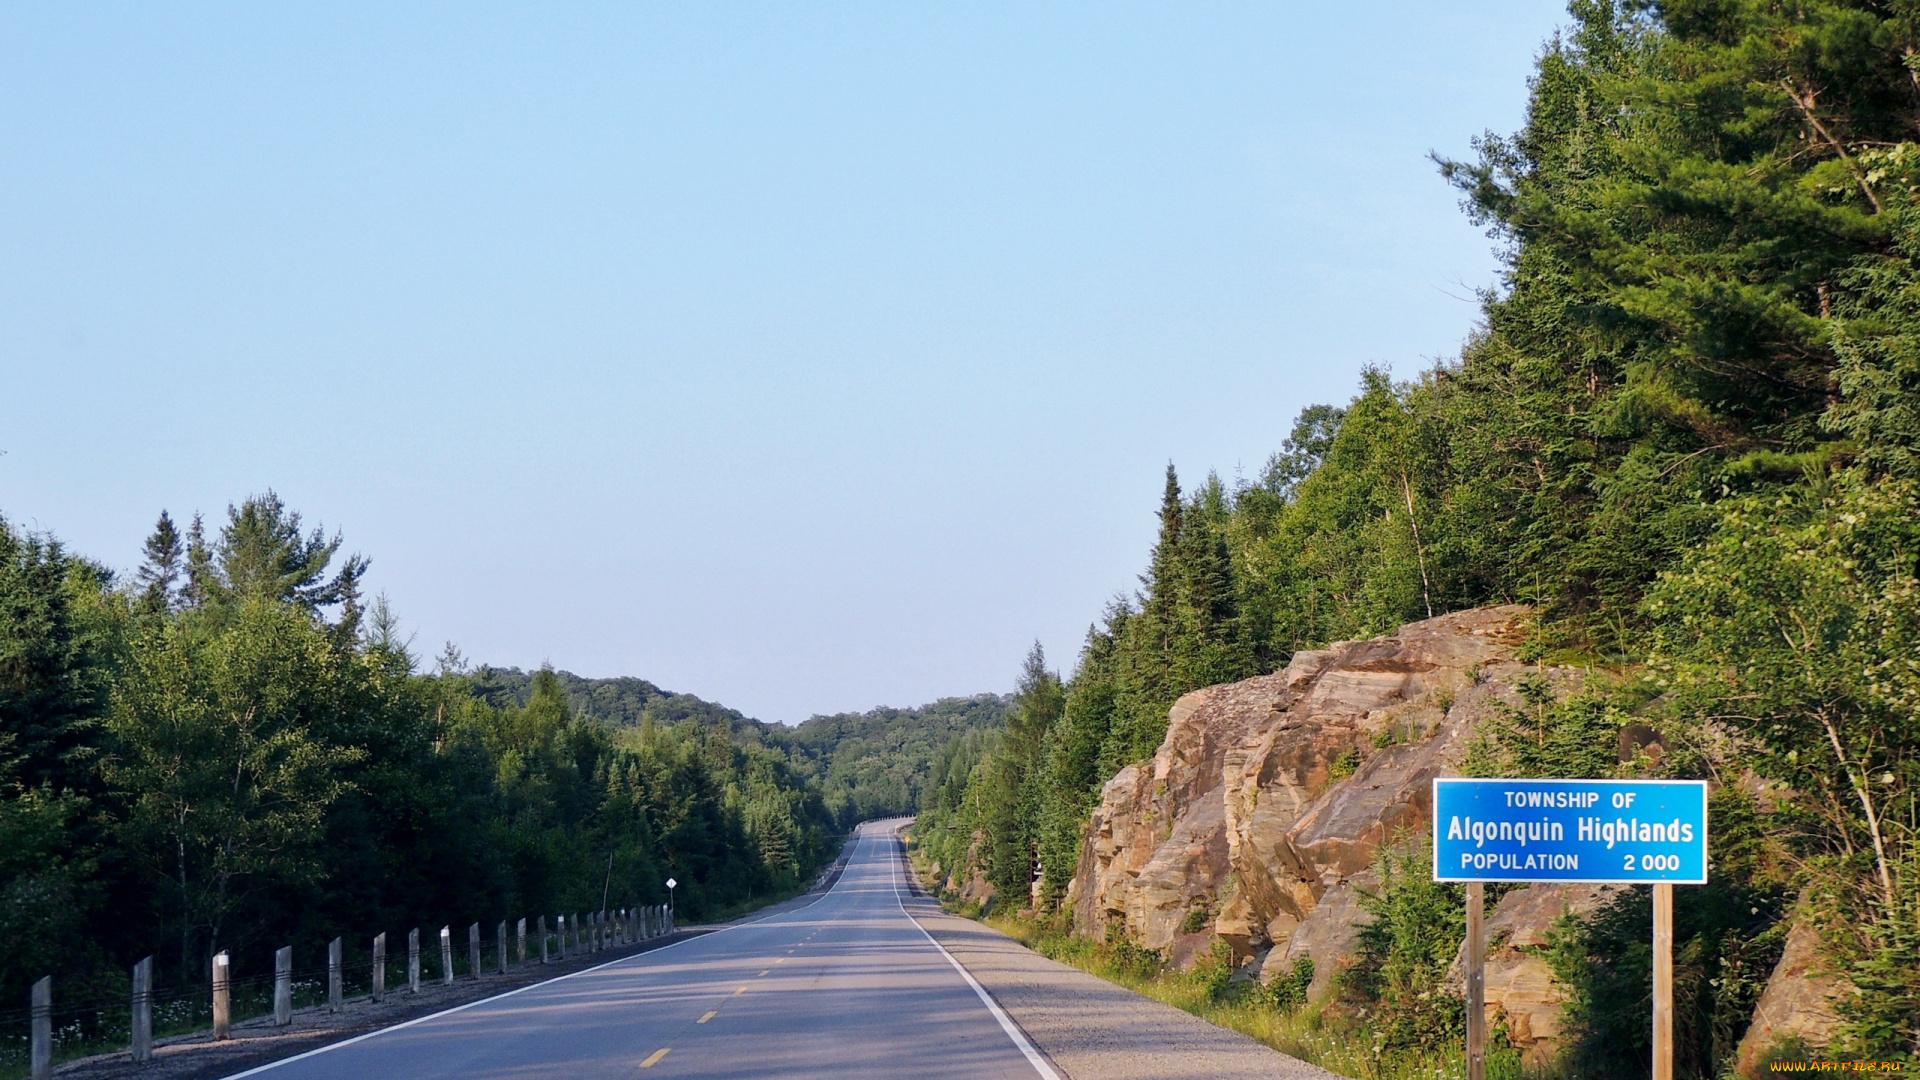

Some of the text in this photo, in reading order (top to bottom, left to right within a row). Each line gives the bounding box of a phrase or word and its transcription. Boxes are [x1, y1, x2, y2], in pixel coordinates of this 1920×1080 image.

[1504, 792, 1636, 808] TOWNSHIP OF
[1448, 816, 1693, 849] Algonquin Highlands
[1461, 853, 1578, 870] POPULATION
